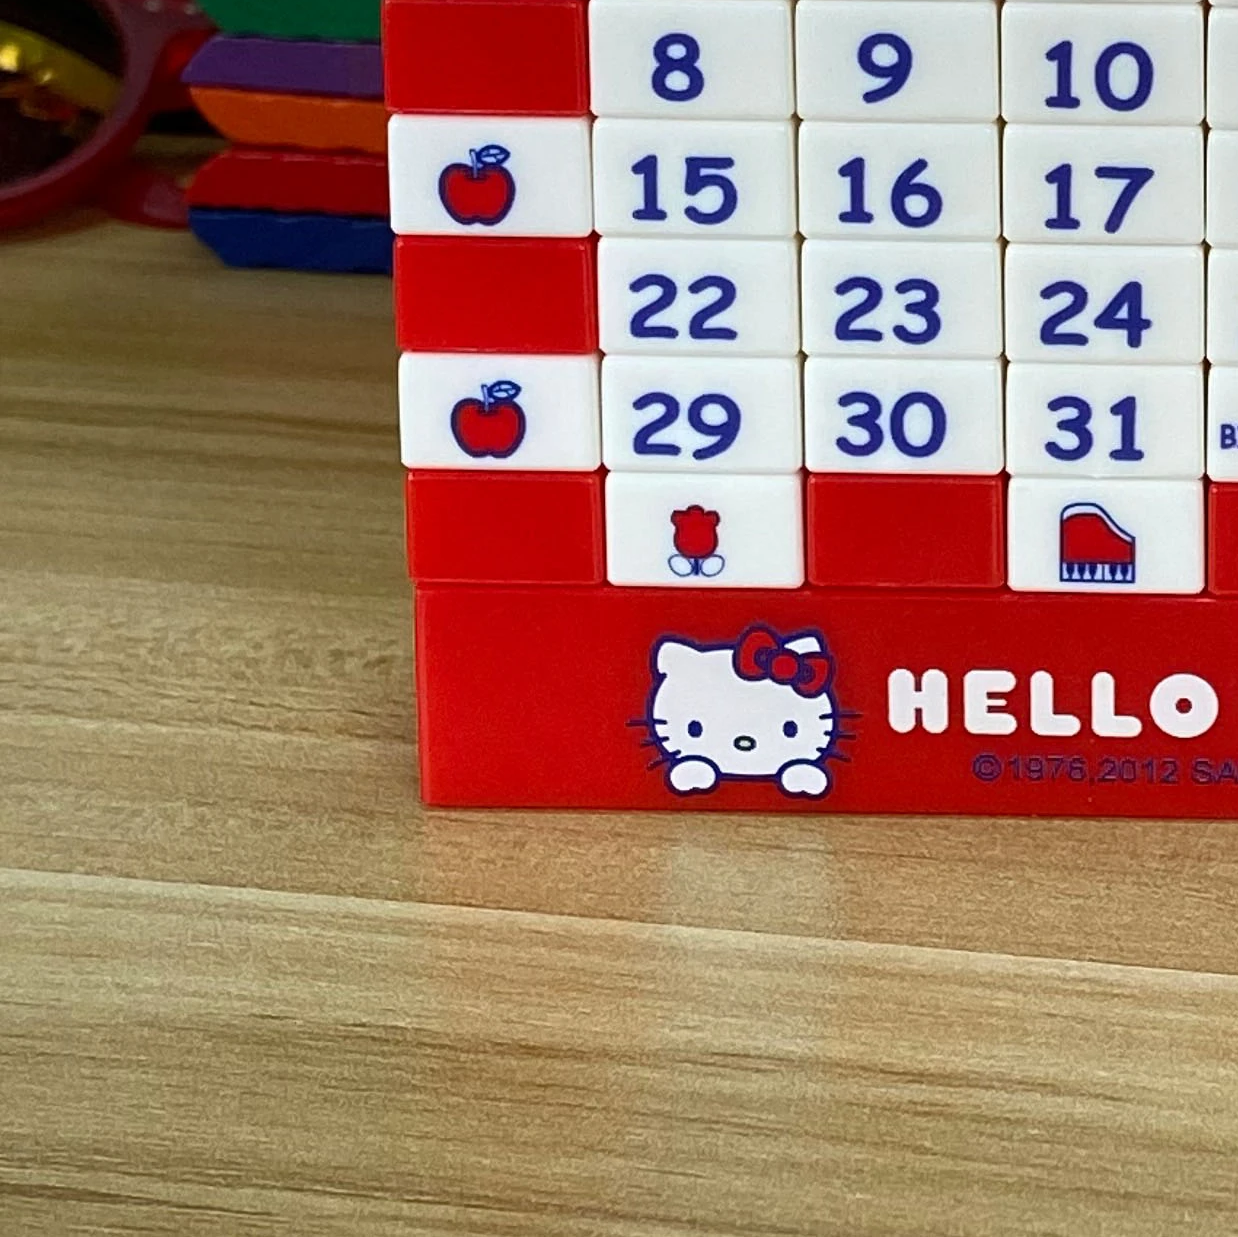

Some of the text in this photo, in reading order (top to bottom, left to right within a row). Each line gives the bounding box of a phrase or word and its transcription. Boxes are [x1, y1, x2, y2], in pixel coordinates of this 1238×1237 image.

[649, 31, 706, 104] 8
[855, 31, 915, 105] 9
[1044, 39, 1156, 112] 10
[630, 152, 740, 227] 15
[837, 155, 944, 230] 16
[1044, 162, 1154, 234] 17
[627, 272, 739, 342] 22
[833, 274, 943, 347] 23
[1038, 278, 1154, 349] 24
[631, 389, 1145, 463] 29 30 31
[887, 668, 1219, 739] HELLO
